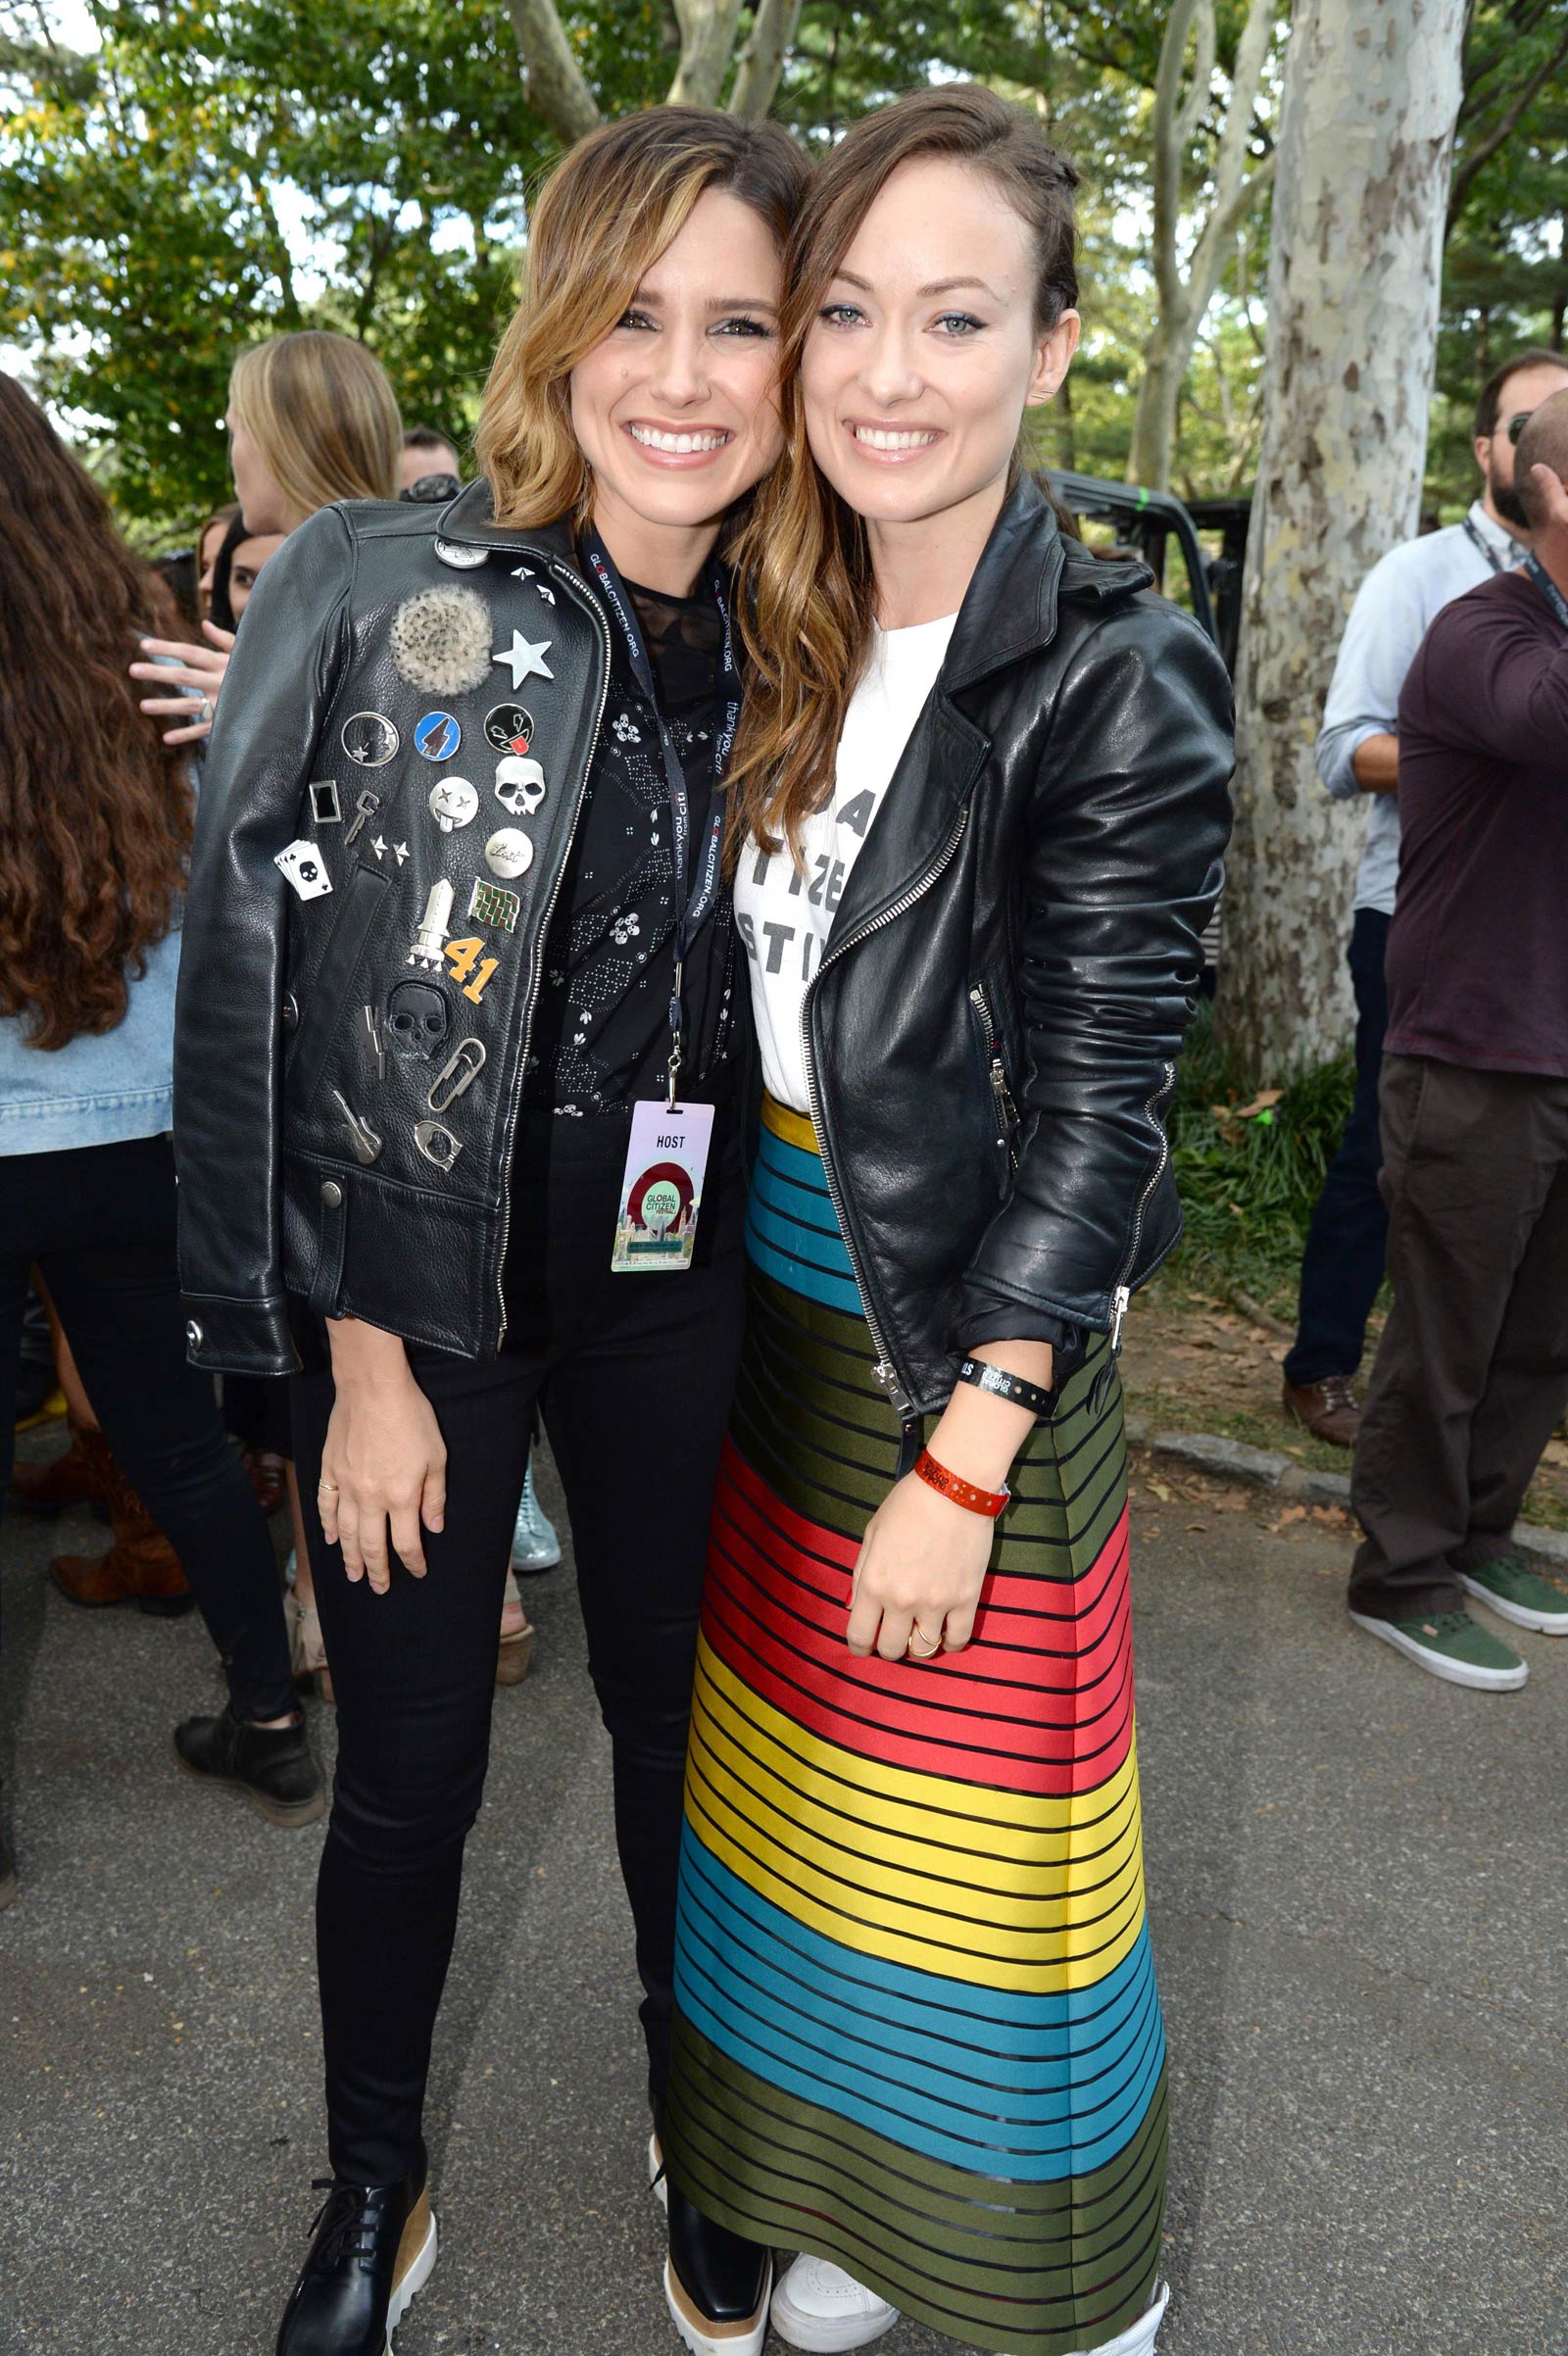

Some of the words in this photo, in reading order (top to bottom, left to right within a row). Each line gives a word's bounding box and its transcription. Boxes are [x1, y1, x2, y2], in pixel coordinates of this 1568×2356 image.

[590, 554, 640, 658] GLOBALCITIZEN.ORG
[722, 702, 739, 756] thankyou
[676, 792, 687, 815] citi
[675, 816, 685, 879] thankyou
[692, 815, 721, 918] GLOBALCITIZEN.ORG
[444, 936, 500, 1006] 41
[657, 1135, 686, 1149] HOST
[647, 1194, 676, 1203] GLOBAL
